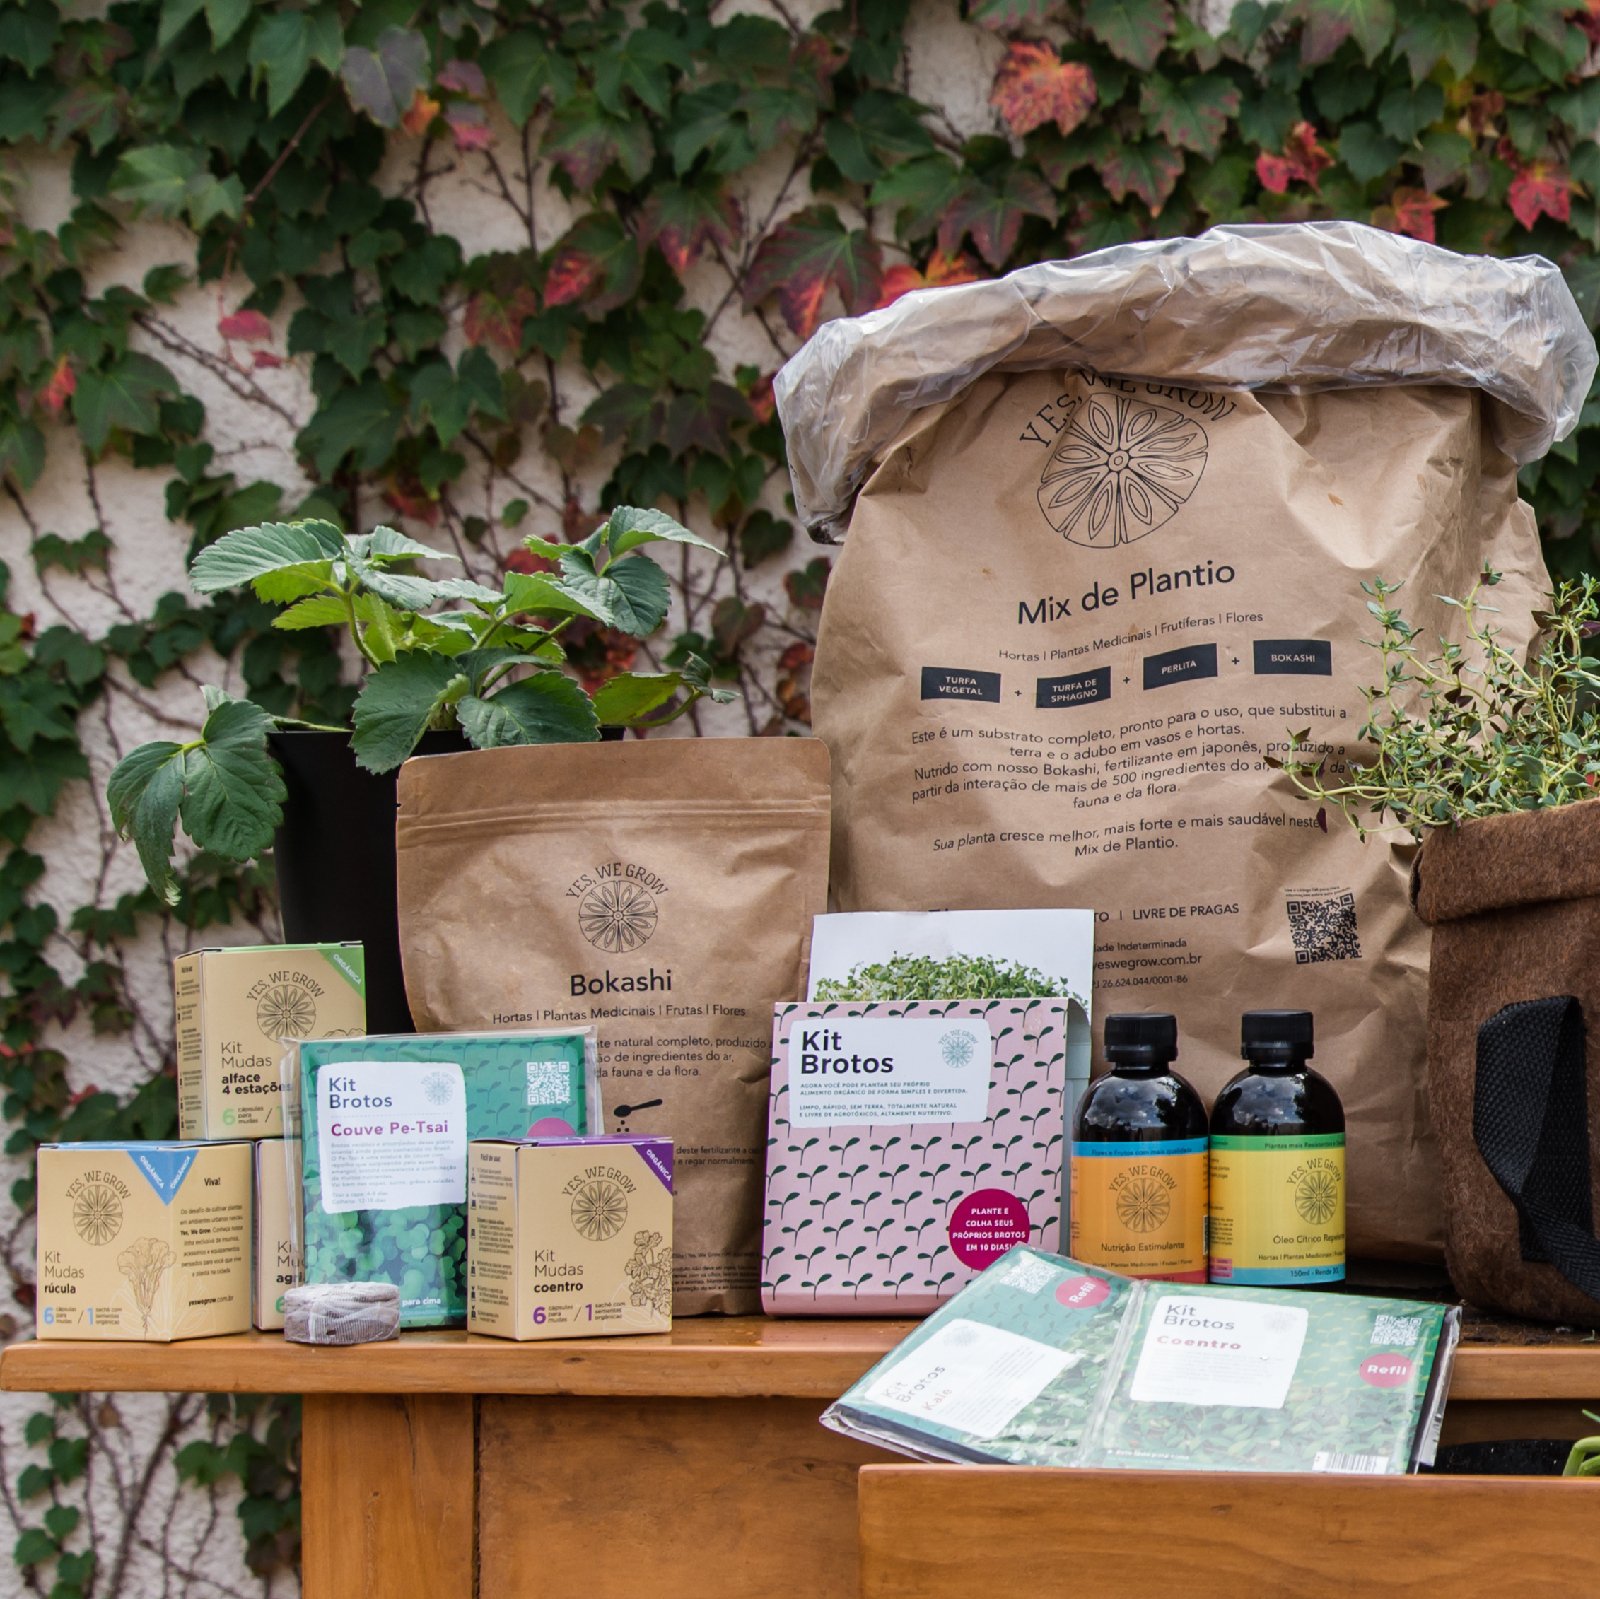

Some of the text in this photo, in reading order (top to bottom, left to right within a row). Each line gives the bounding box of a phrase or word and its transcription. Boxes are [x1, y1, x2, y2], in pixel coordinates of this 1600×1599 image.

[1020, 393, 1083, 448] YES,
[1018, 560, 1235, 624] Mix de Plantio
[999, 612, 1264, 662] Hortas Plantas Medicinais Frutíferas Flores
[1270, 653, 1316, 663] BOKASHI
[1161, 660, 1197, 675] PERLITA
[945, 676, 977, 686] TURFA
[1051, 678, 1097, 692] TURFA DE
[939, 686, 983, 696] VEGETAL
[1050, 689, 1098, 703] SPHAGNO
[912, 703, 1335, 748] Este substrato completo, pronto para uso, que substitui
[1010, 724, 1245, 760] terra adubo vasos hortas.
[914, 740, 1262, 780] Nutrido com nosso Bokashi, fertilizante japonês,
[912, 761, 1226, 804] partir interação mais 500 ingredientes
[1073, 783, 1180, 808] fauna flora.
[933, 812, 1319, 851] Sua planta cresce melhor, mais forte e mais saudável neste
[1074, 835, 1178, 857] Mix Plantio.
[565, 862, 669, 899] YES, WE GROW
[1133, 904, 1240, 921] LIVRE DE PRAGAS
[1117, 938, 1187, 951] Indeterminada
[333, 954, 362, 985] ORGÂNICA
[247, 971, 325, 1001] YES, WE GROW
[570, 968, 672, 996] Bokashi
[493, 1004, 746, 1024] Hortas Plantas Medicinais Frutas Flores
[221, 1041, 243, 1054] Kit
[614, 1036, 653, 1047] natural
[657, 1035, 713, 1049] completo,
[716, 1037, 767, 1050] produzido
[802, 1029, 842, 1051] Kit
[221, 1055, 272, 1069] Mudas
[614, 1052, 630, 1063] de
[633, 1050, 703, 1065] ingredientes
[706, 1049, 720, 1061] do
[801, 1054, 894, 1074] Brotos
[222, 1072, 261, 1085] alface
[612, 1065, 702, 1077] fauna da flora.
[222, 1085, 231, 1095] 4
[329, 1077, 356, 1092] Kit
[329, 1093, 393, 1109] Brotos
[222, 1108, 236, 1126] 6
[331, 1120, 448, 1137] Couve Pe-Tsai
[646, 1149, 672, 1182] ORGÂNICA
[1287, 1157, 1343, 1185] YES, WE GROW
[66, 1170, 131, 1199] YES, WE GROW
[562, 1165, 637, 1196] YES, WE GROW
[1109, 1165, 1177, 1192] YES, WE GROW
[994, 1219, 1014, 1227] SEUS
[952, 1230, 1026, 1239] PRÓPRIOS BROTOS
[1272, 1234, 1321, 1244] Óleo Cítrico
[980, 1243, 989, 1251] 10
[1101, 1241, 1185, 1253] Nutrição Estimulante
[44, 1250, 61, 1263] Kit
[535, 1249, 555, 1262] Kit
[44, 1265, 85, 1279] Mudas
[535, 1263, 584, 1278] Mudas
[45, 1282, 76, 1294] rúcula
[534, 1281, 584, 1293] coentro
[1068, 1282, 1097, 1303] Refil
[402, 1296, 441, 1308] para cima
[1166, 1304, 1197, 1316] Kit
[43, 1306, 55, 1325] 6
[533, 1306, 547, 1324] 6
[585, 1303, 593, 1321] 1
[1163, 1315, 1236, 1330] Brotos
[1156, 1335, 1242, 1350] Coentro
[1367, 1364, 1407, 1376] Refil
[882, 1382, 909, 1398] Kit
[896, 1366, 946, 1403] Brotos
[924, 1389, 952, 1411] Kale
